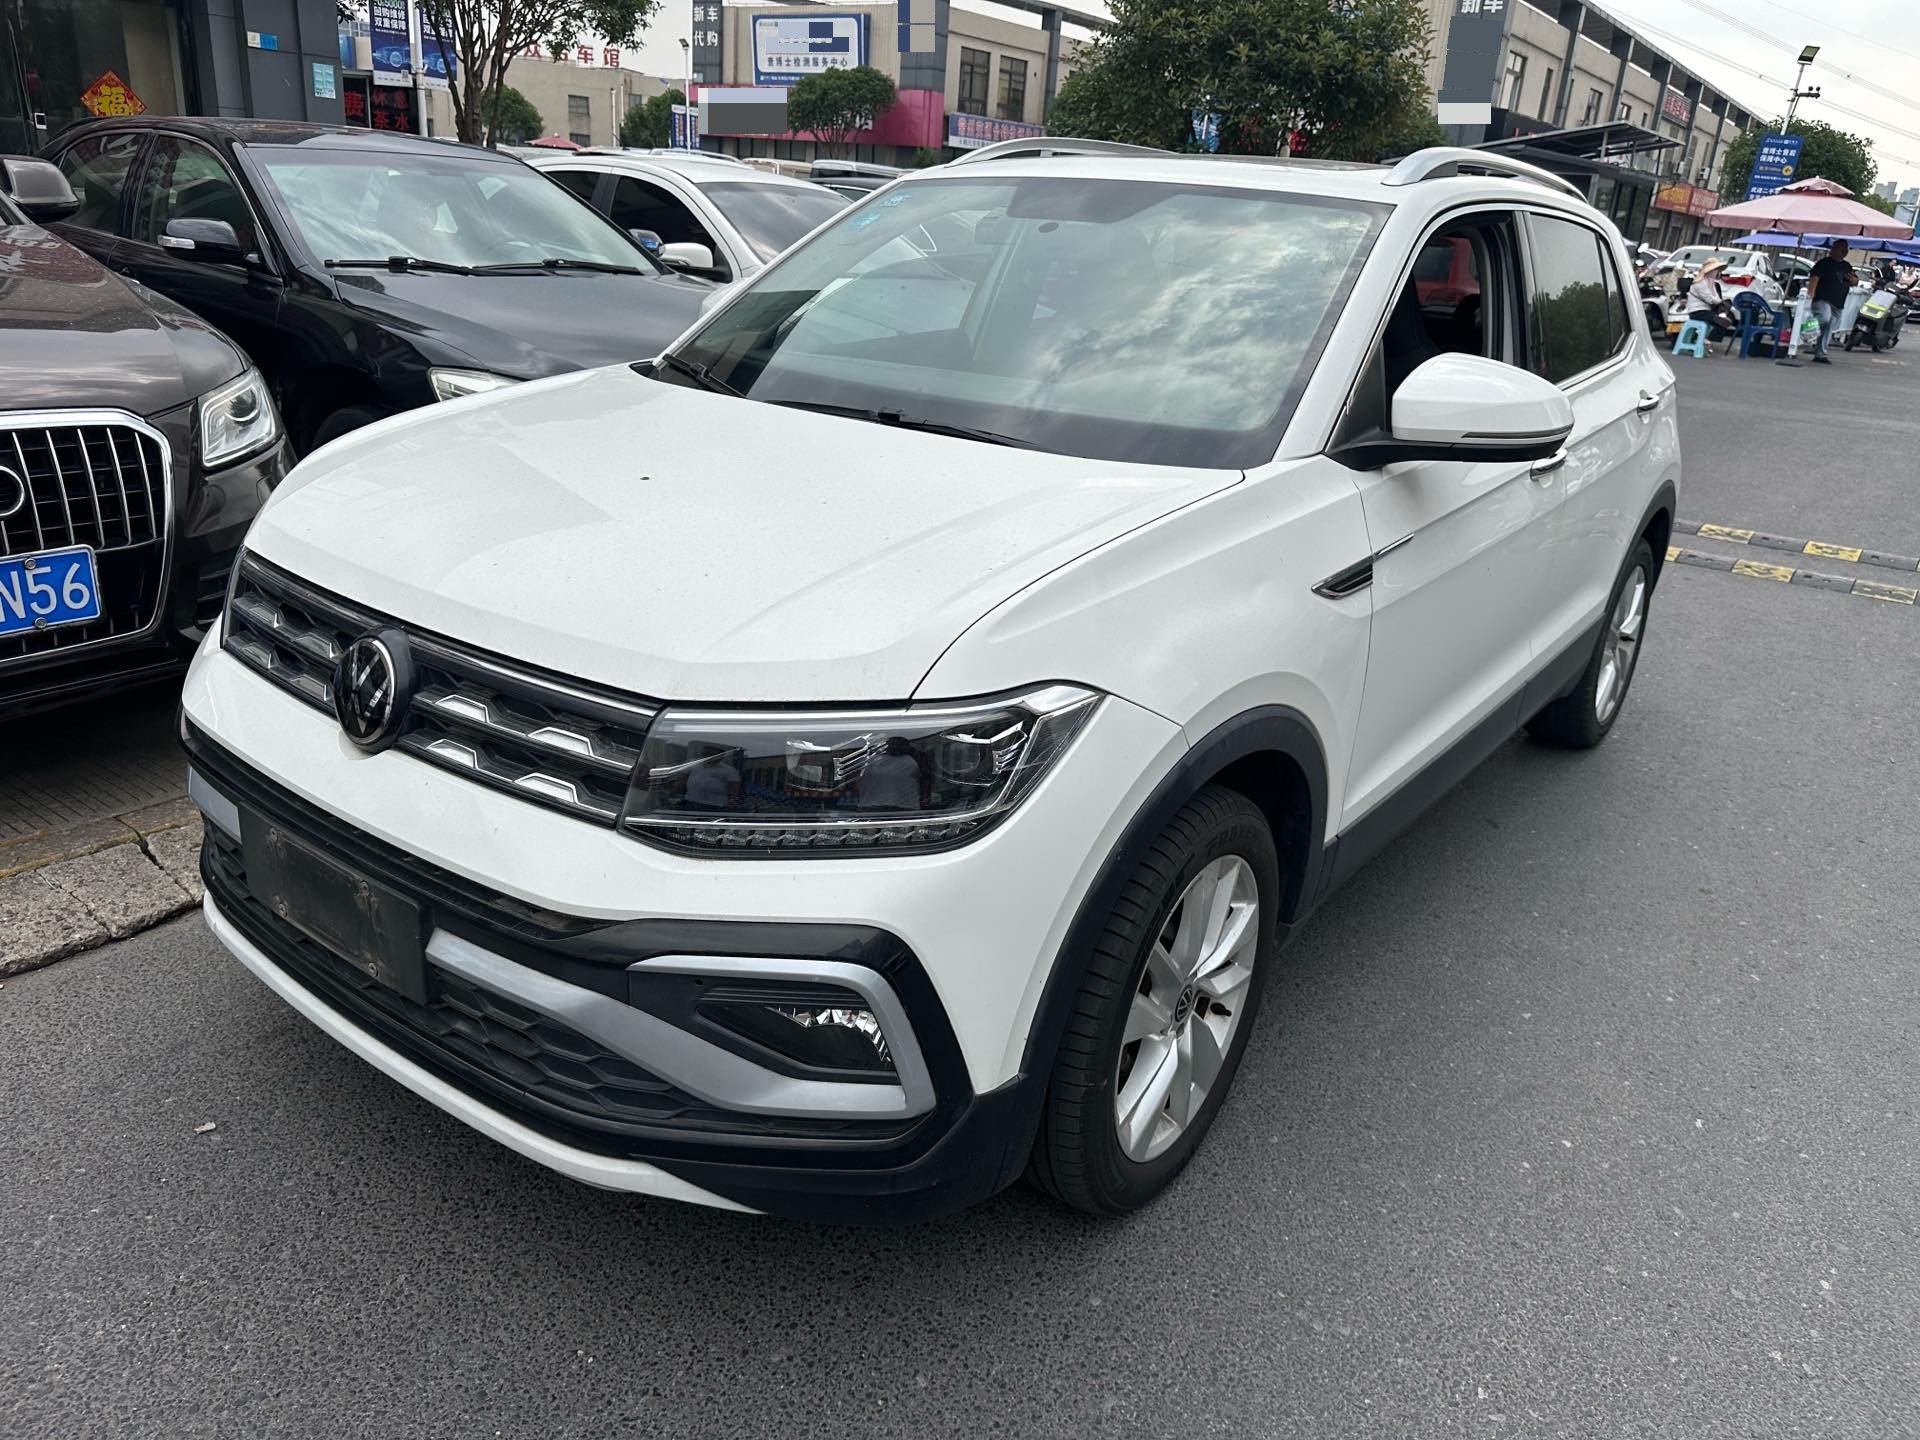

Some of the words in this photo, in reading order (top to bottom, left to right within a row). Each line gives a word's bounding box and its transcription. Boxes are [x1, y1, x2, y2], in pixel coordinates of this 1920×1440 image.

[693, 6, 718, 22] 新车
[694, 30, 719, 46] 代购
[767, 56, 848, 67] 查博士检测服务中心
[97, 84, 130, 117] 福
[0, 562, 91, 623] N56
